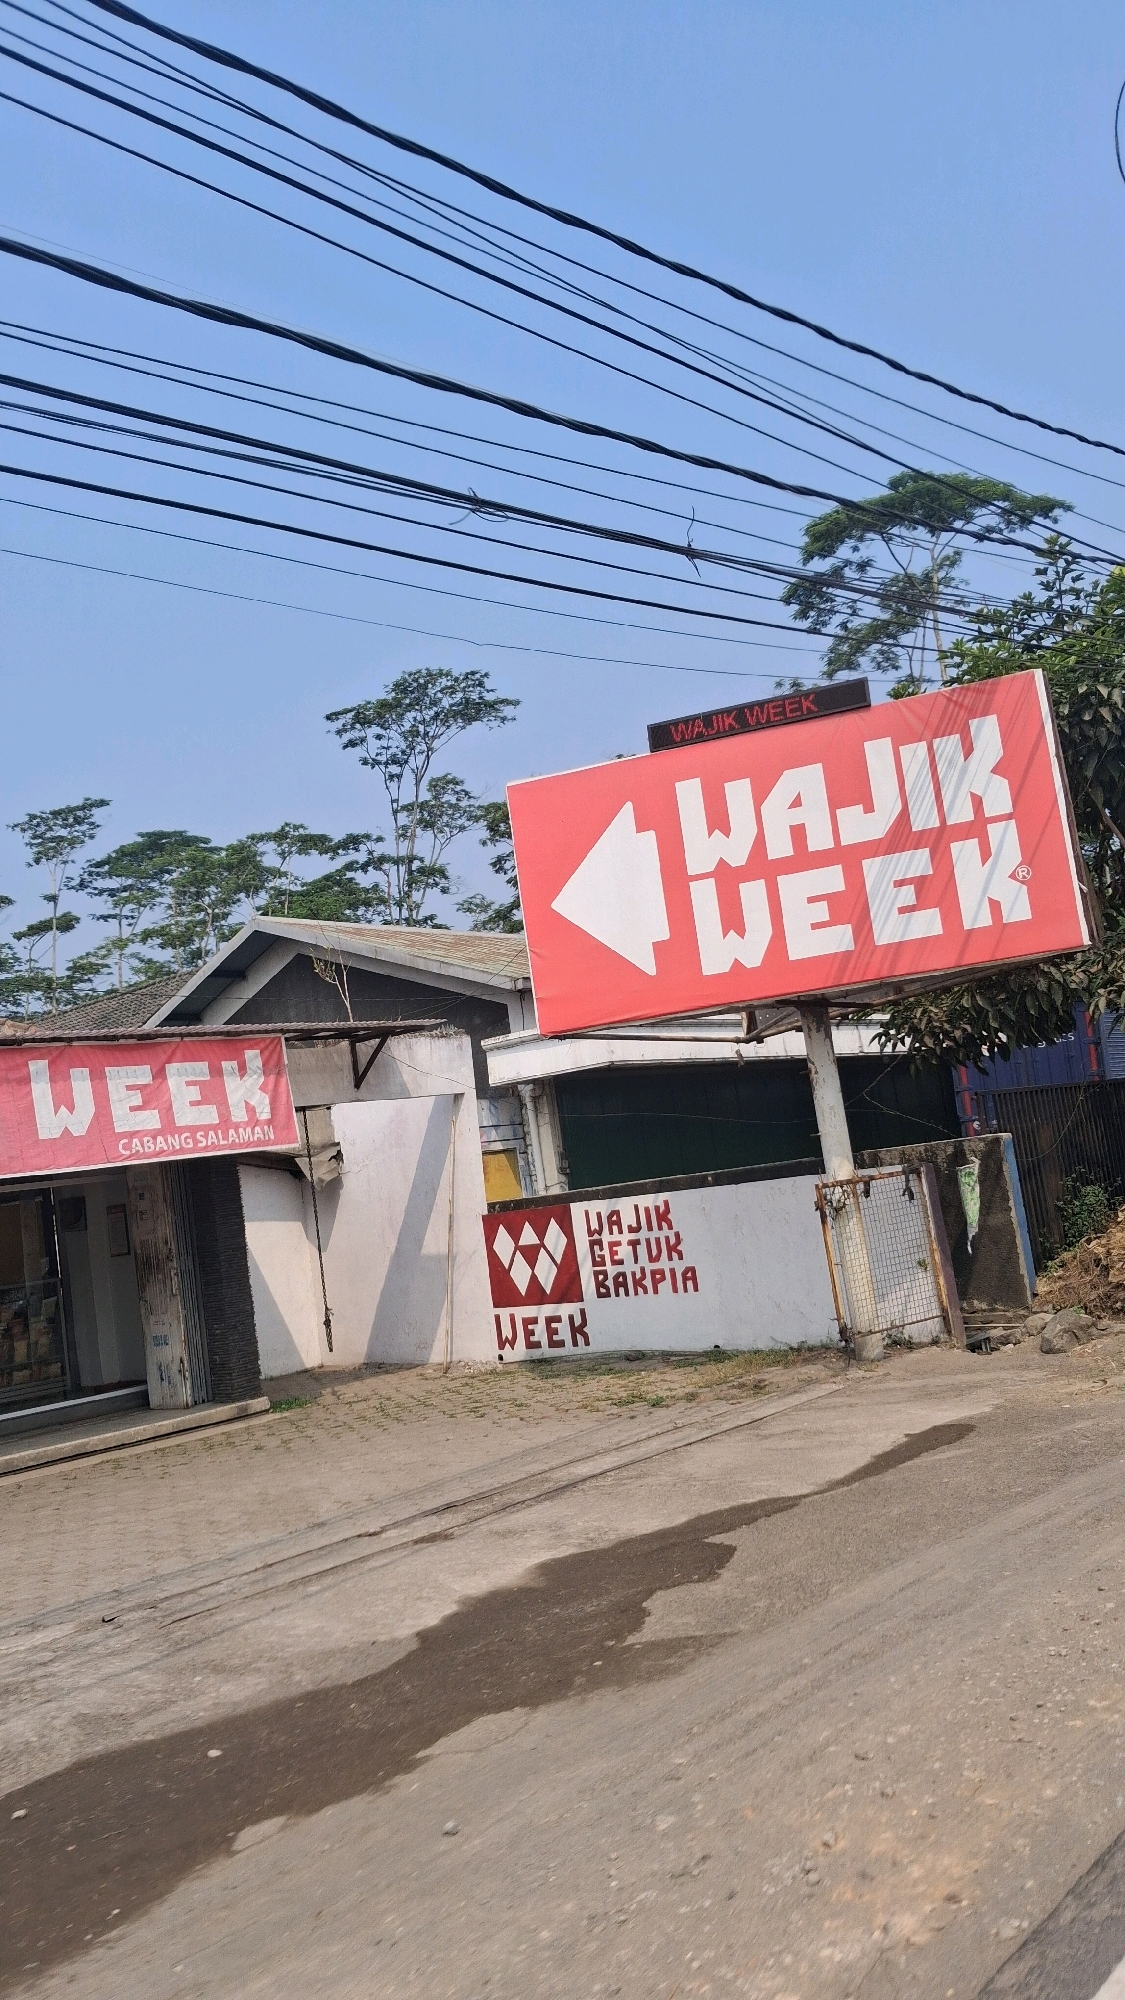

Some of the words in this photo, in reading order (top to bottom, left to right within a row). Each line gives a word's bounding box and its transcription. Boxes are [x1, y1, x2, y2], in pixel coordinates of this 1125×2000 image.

[669, 710, 740, 742] WAJIK
[744, 693, 818, 726] WEEK
[675, 714, 1013, 875] WAJIK
[689, 819, 1033, 976] WEEK
[28, 1050, 272, 1139] WEEK
[118, 1132, 194, 1155] CABANG
[196, 1125, 275, 1146] SALAMAN
[584, 1199, 673, 1237] WAJIK
[588, 1230, 684, 1268] GETUK
[593, 1266, 700, 1299] BAKPIA
[494, 1308, 591, 1351] WEEK
